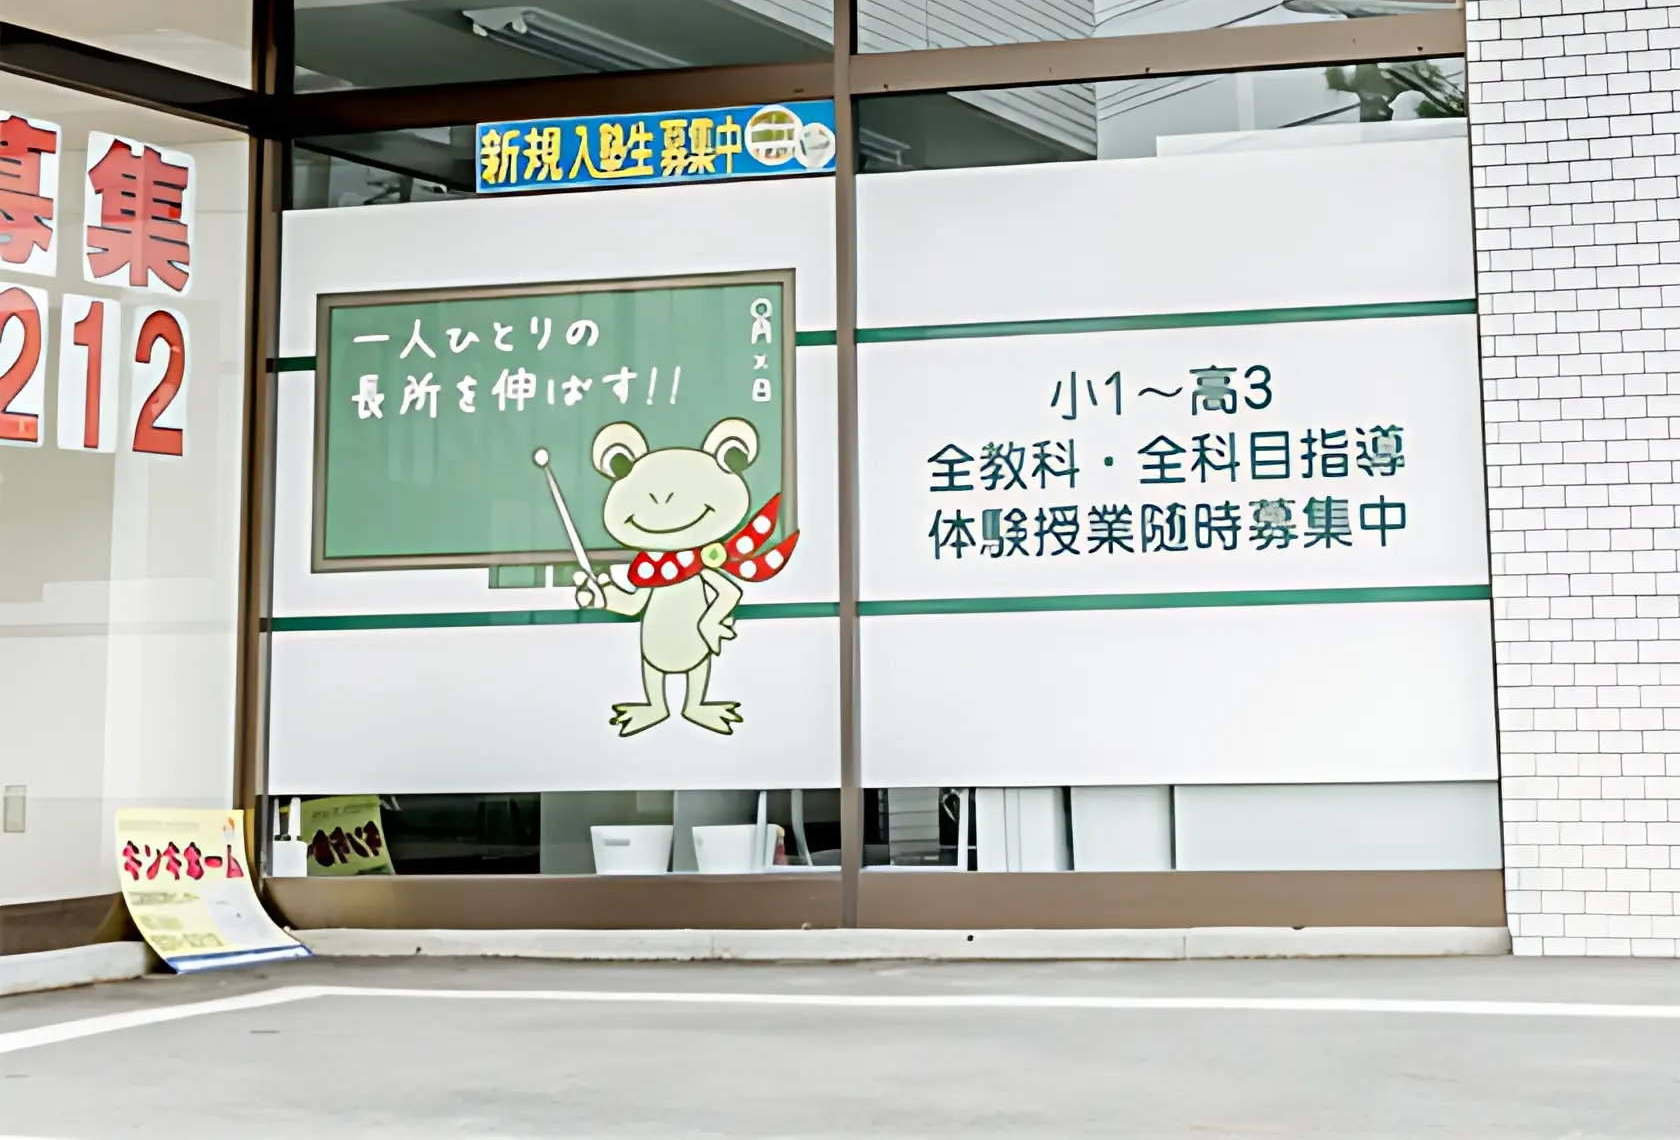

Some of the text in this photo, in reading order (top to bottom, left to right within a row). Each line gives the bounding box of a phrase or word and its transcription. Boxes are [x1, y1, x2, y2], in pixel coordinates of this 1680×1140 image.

[480, 114, 742, 184] 新規入塾生募集中
[353, 316, 600, 359] 一人ひとりの
[928, 496, 1408, 560] 体験授業随時募集中
